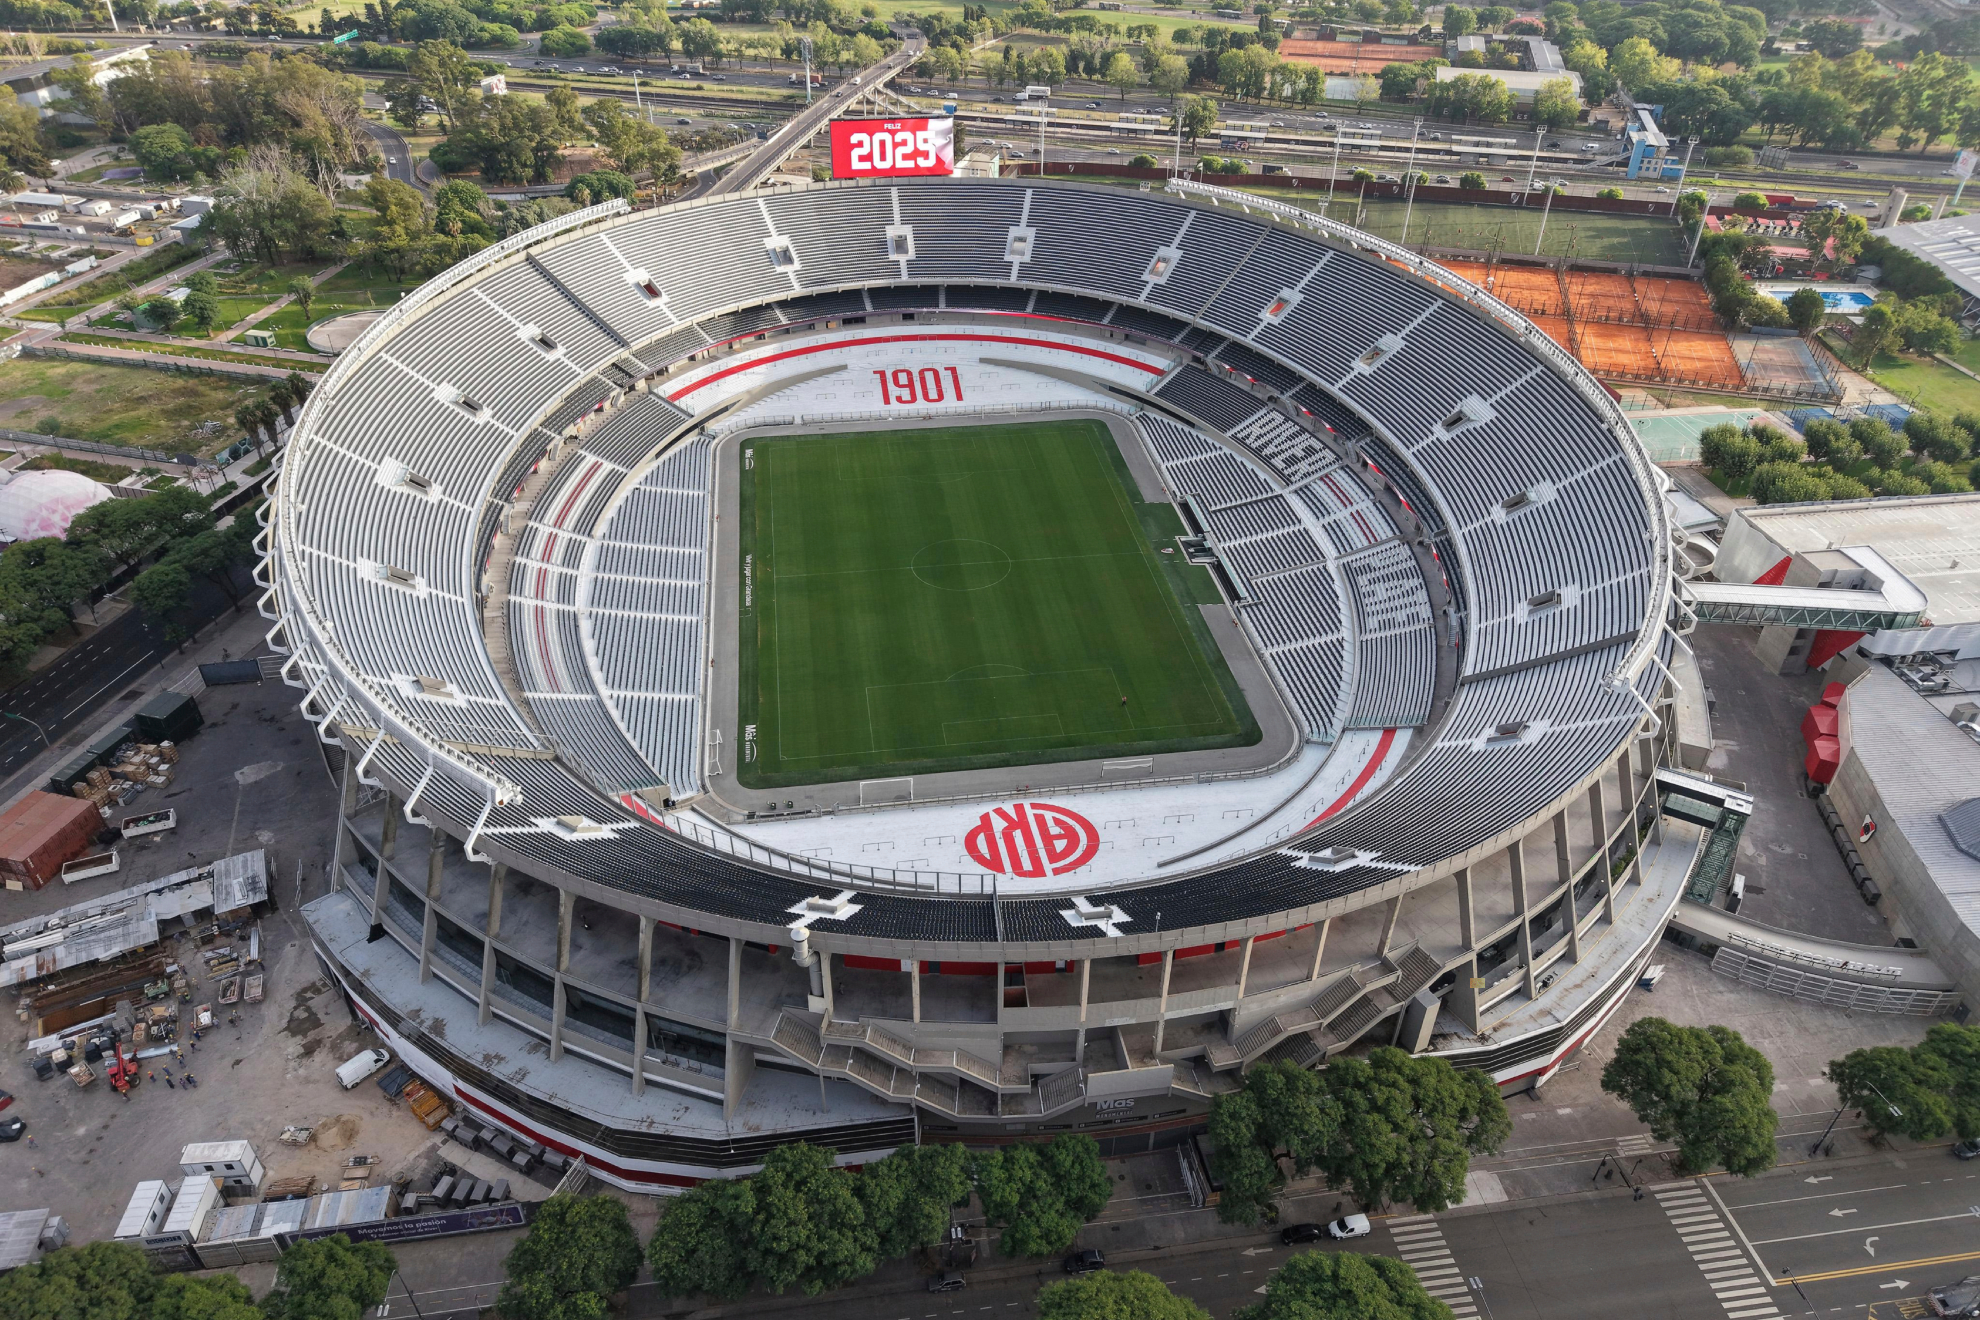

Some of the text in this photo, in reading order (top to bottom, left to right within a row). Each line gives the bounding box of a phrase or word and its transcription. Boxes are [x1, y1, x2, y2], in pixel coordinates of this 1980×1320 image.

[850, 130, 937, 170] 2025
[872, 366, 964, 405] 1901
[964, 802, 1101, 879] CARP
[357, 1225, 403, 1235] Movamos
[415, 1219, 447, 1228] pasión
[1895, 1299, 1928, 1319] BUS
